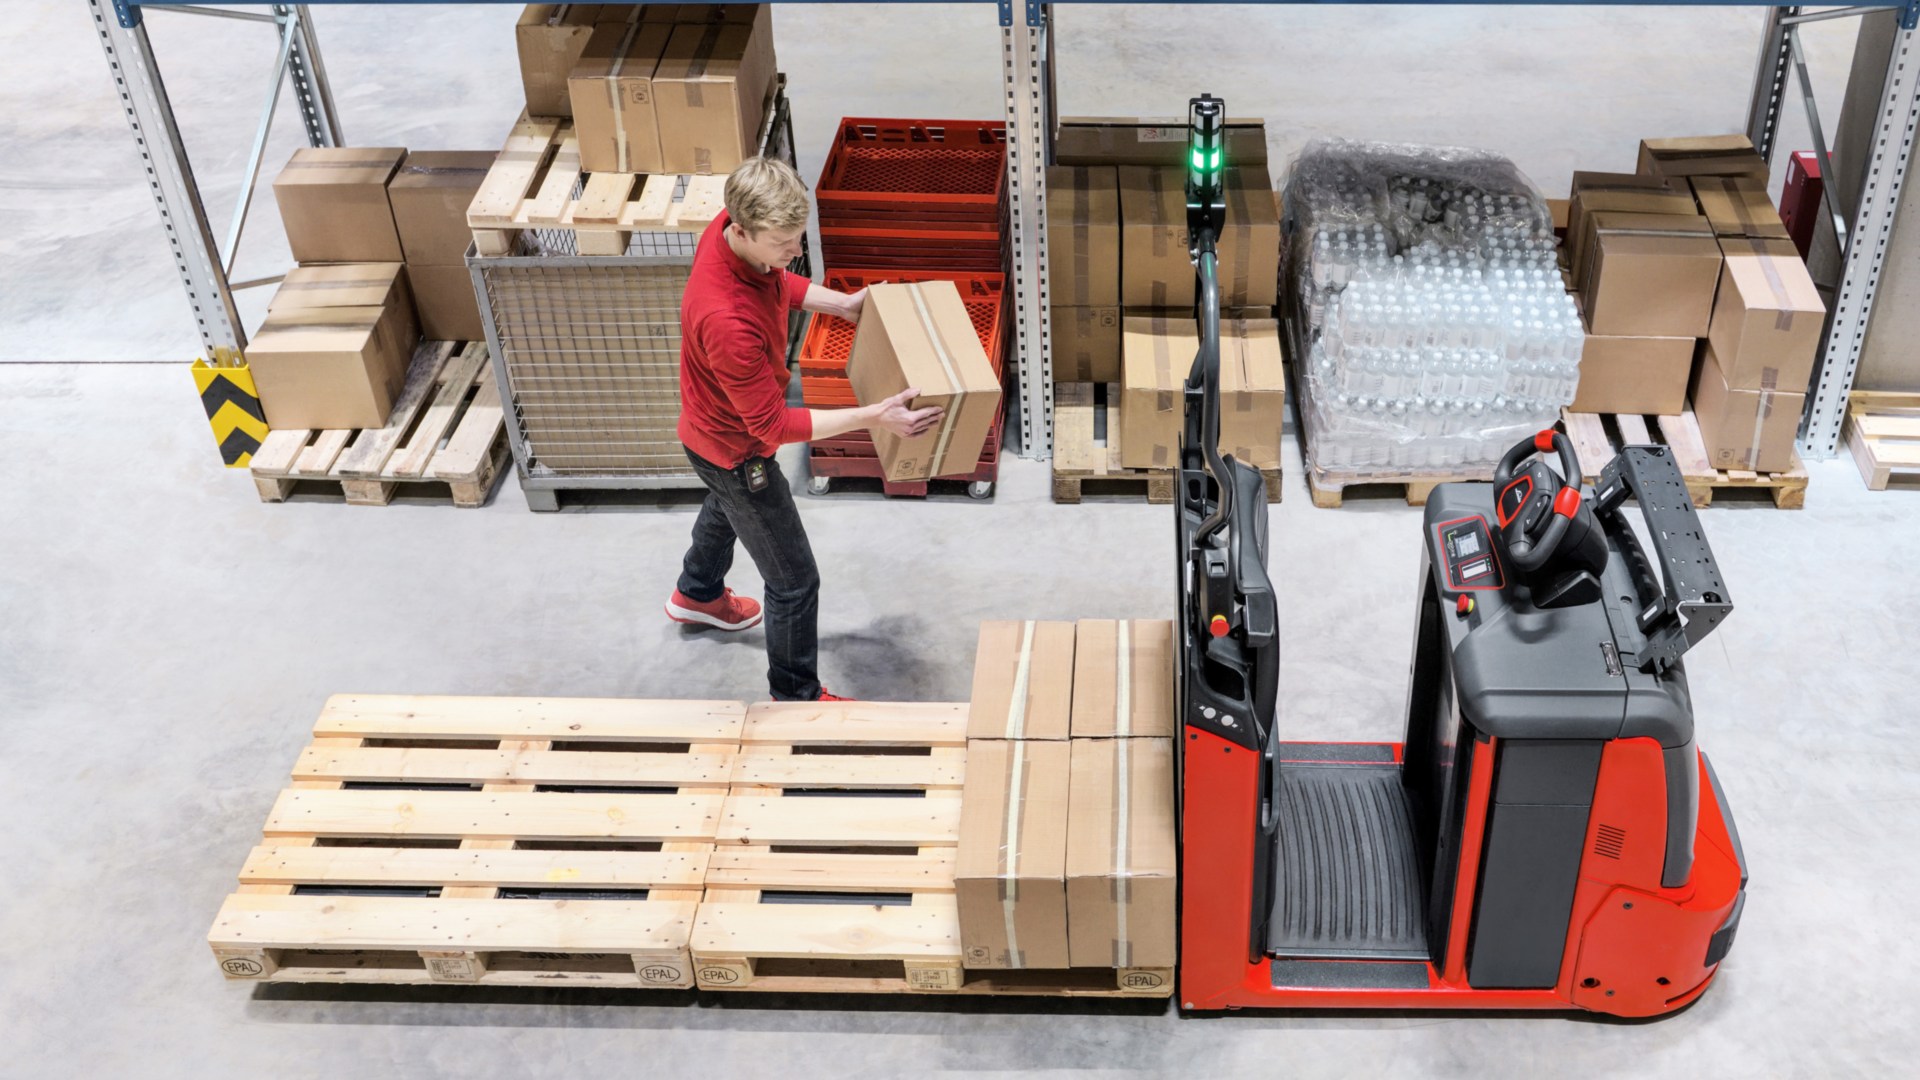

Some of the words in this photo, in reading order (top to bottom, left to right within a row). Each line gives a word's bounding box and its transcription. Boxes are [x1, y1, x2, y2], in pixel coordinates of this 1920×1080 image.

[226, 962, 257, 973] EPAL
[645, 968, 675, 979] EPAL
[703, 970, 733, 981] EPAL
[1128, 975, 1157, 986] EPAL
